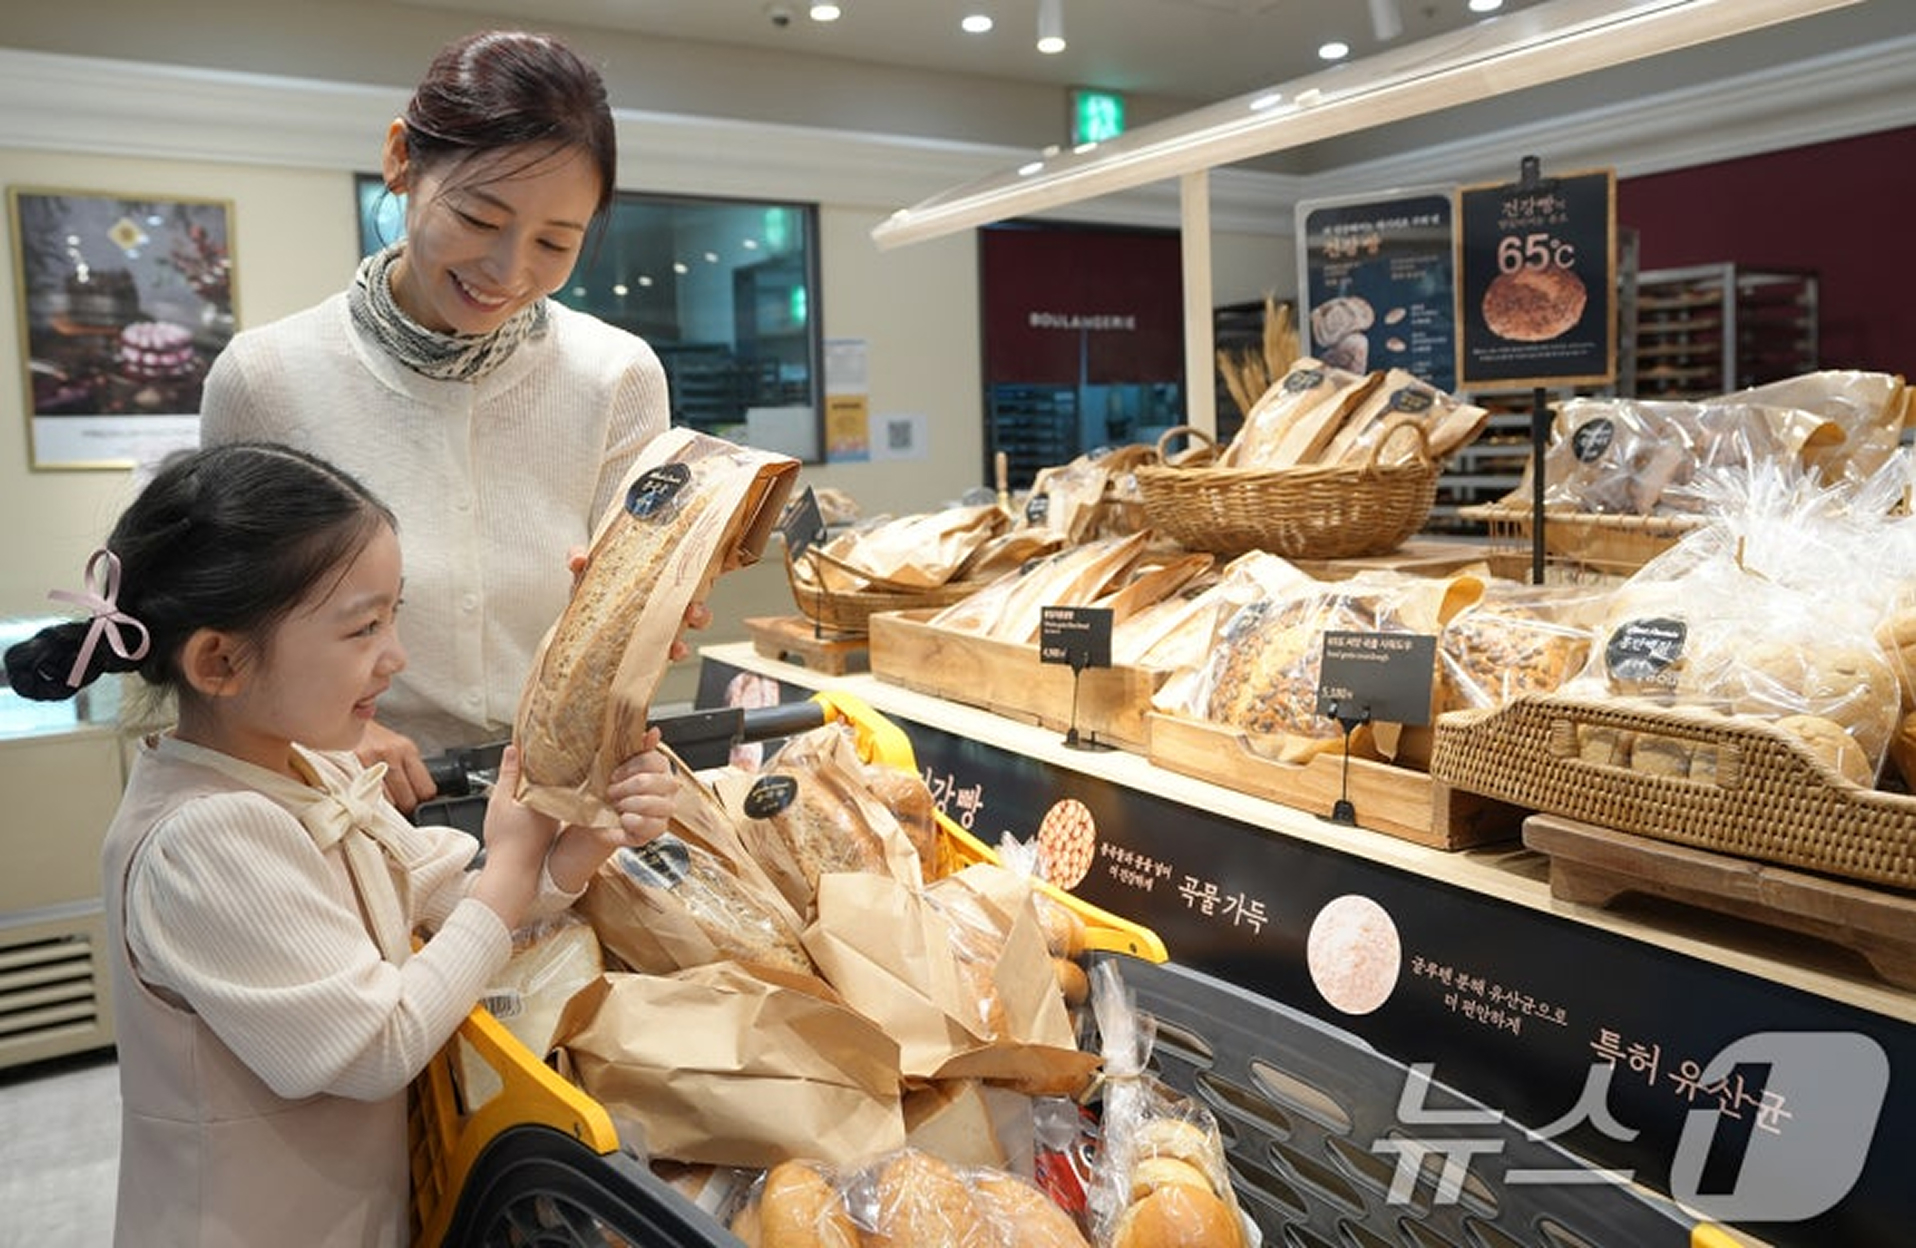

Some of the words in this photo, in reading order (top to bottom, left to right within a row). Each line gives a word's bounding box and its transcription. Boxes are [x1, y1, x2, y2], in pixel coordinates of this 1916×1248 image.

[1029, 311, 1136, 330] BOULANGERIE
[926, 766, 984, 830] 강빵
[1177, 874, 1221, 917] 곡물
[1221, 892, 1269, 935] 가득
[1411, 954, 1454, 987] 글루텐
[1455, 972, 1486, 998] 분해
[1488, 984, 1569, 1027] 유산균으로
[1444, 992, 1459, 1013] 더
[1461, 999, 1523, 1036] 편안하게
[1589, 1027, 1661, 1087] 특허
[1667, 1059, 1793, 1137] 유산균
